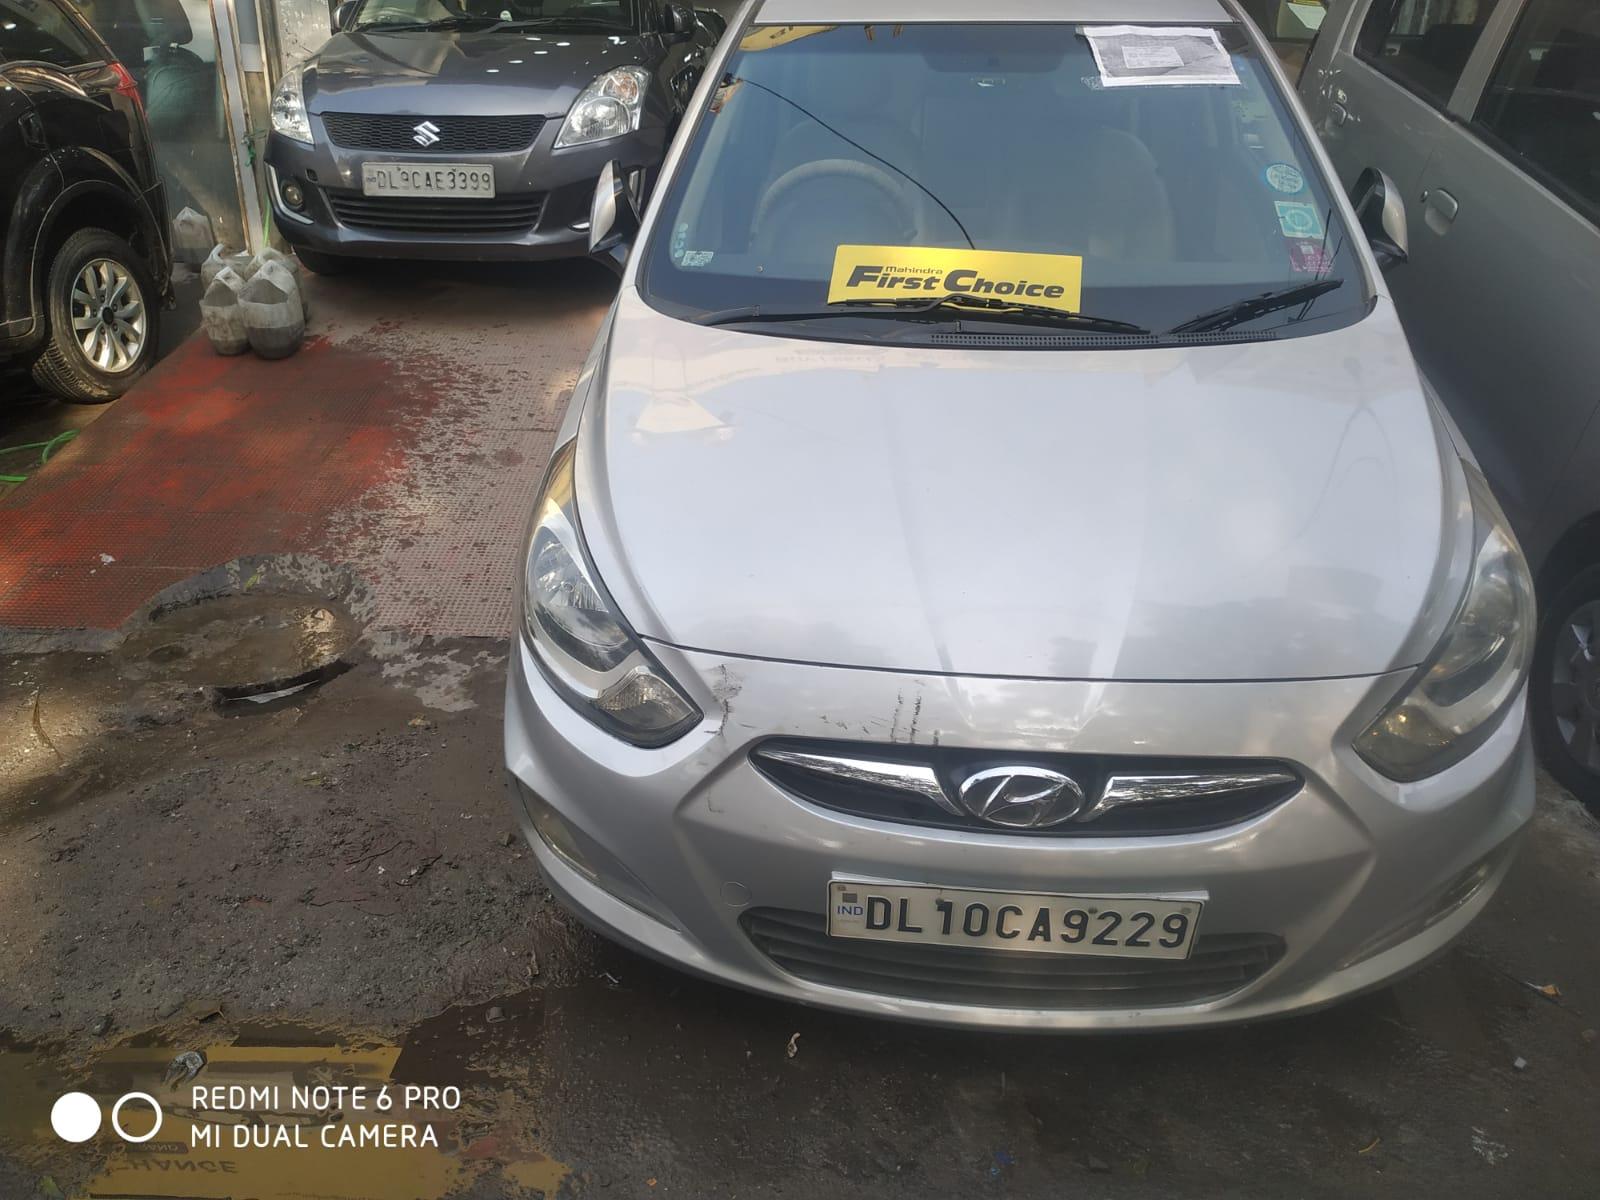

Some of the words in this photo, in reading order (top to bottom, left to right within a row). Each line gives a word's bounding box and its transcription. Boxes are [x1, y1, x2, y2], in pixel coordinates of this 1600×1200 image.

[885, 266, 943, 275] Mahindra
[846, 265, 941, 290] First
[944, 269, 1065, 299] Choice
[836, 905, 863, 917] IND
